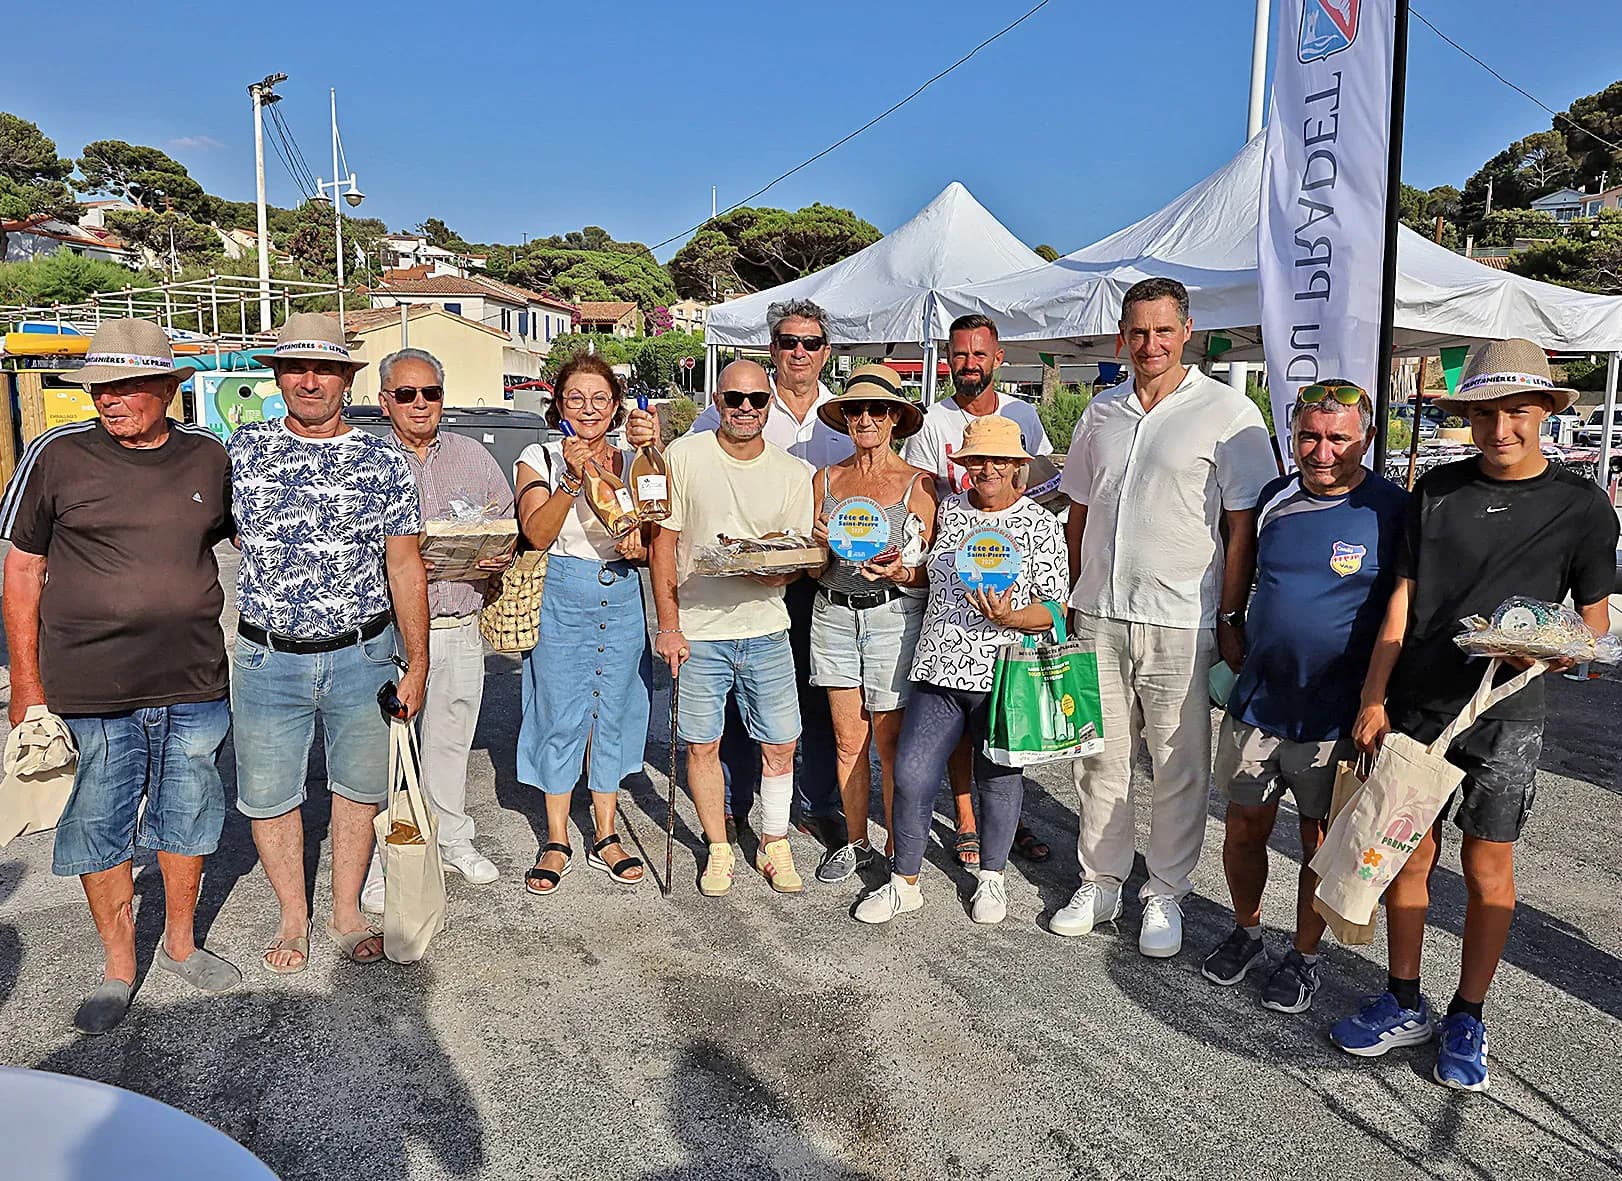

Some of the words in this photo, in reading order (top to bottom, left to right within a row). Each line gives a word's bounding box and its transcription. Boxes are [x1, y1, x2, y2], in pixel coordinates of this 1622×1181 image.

[838, 513, 857, 521] Fête
[967, 544, 986, 552] Fête
[1381, 836, 1415, 854] PRINT
